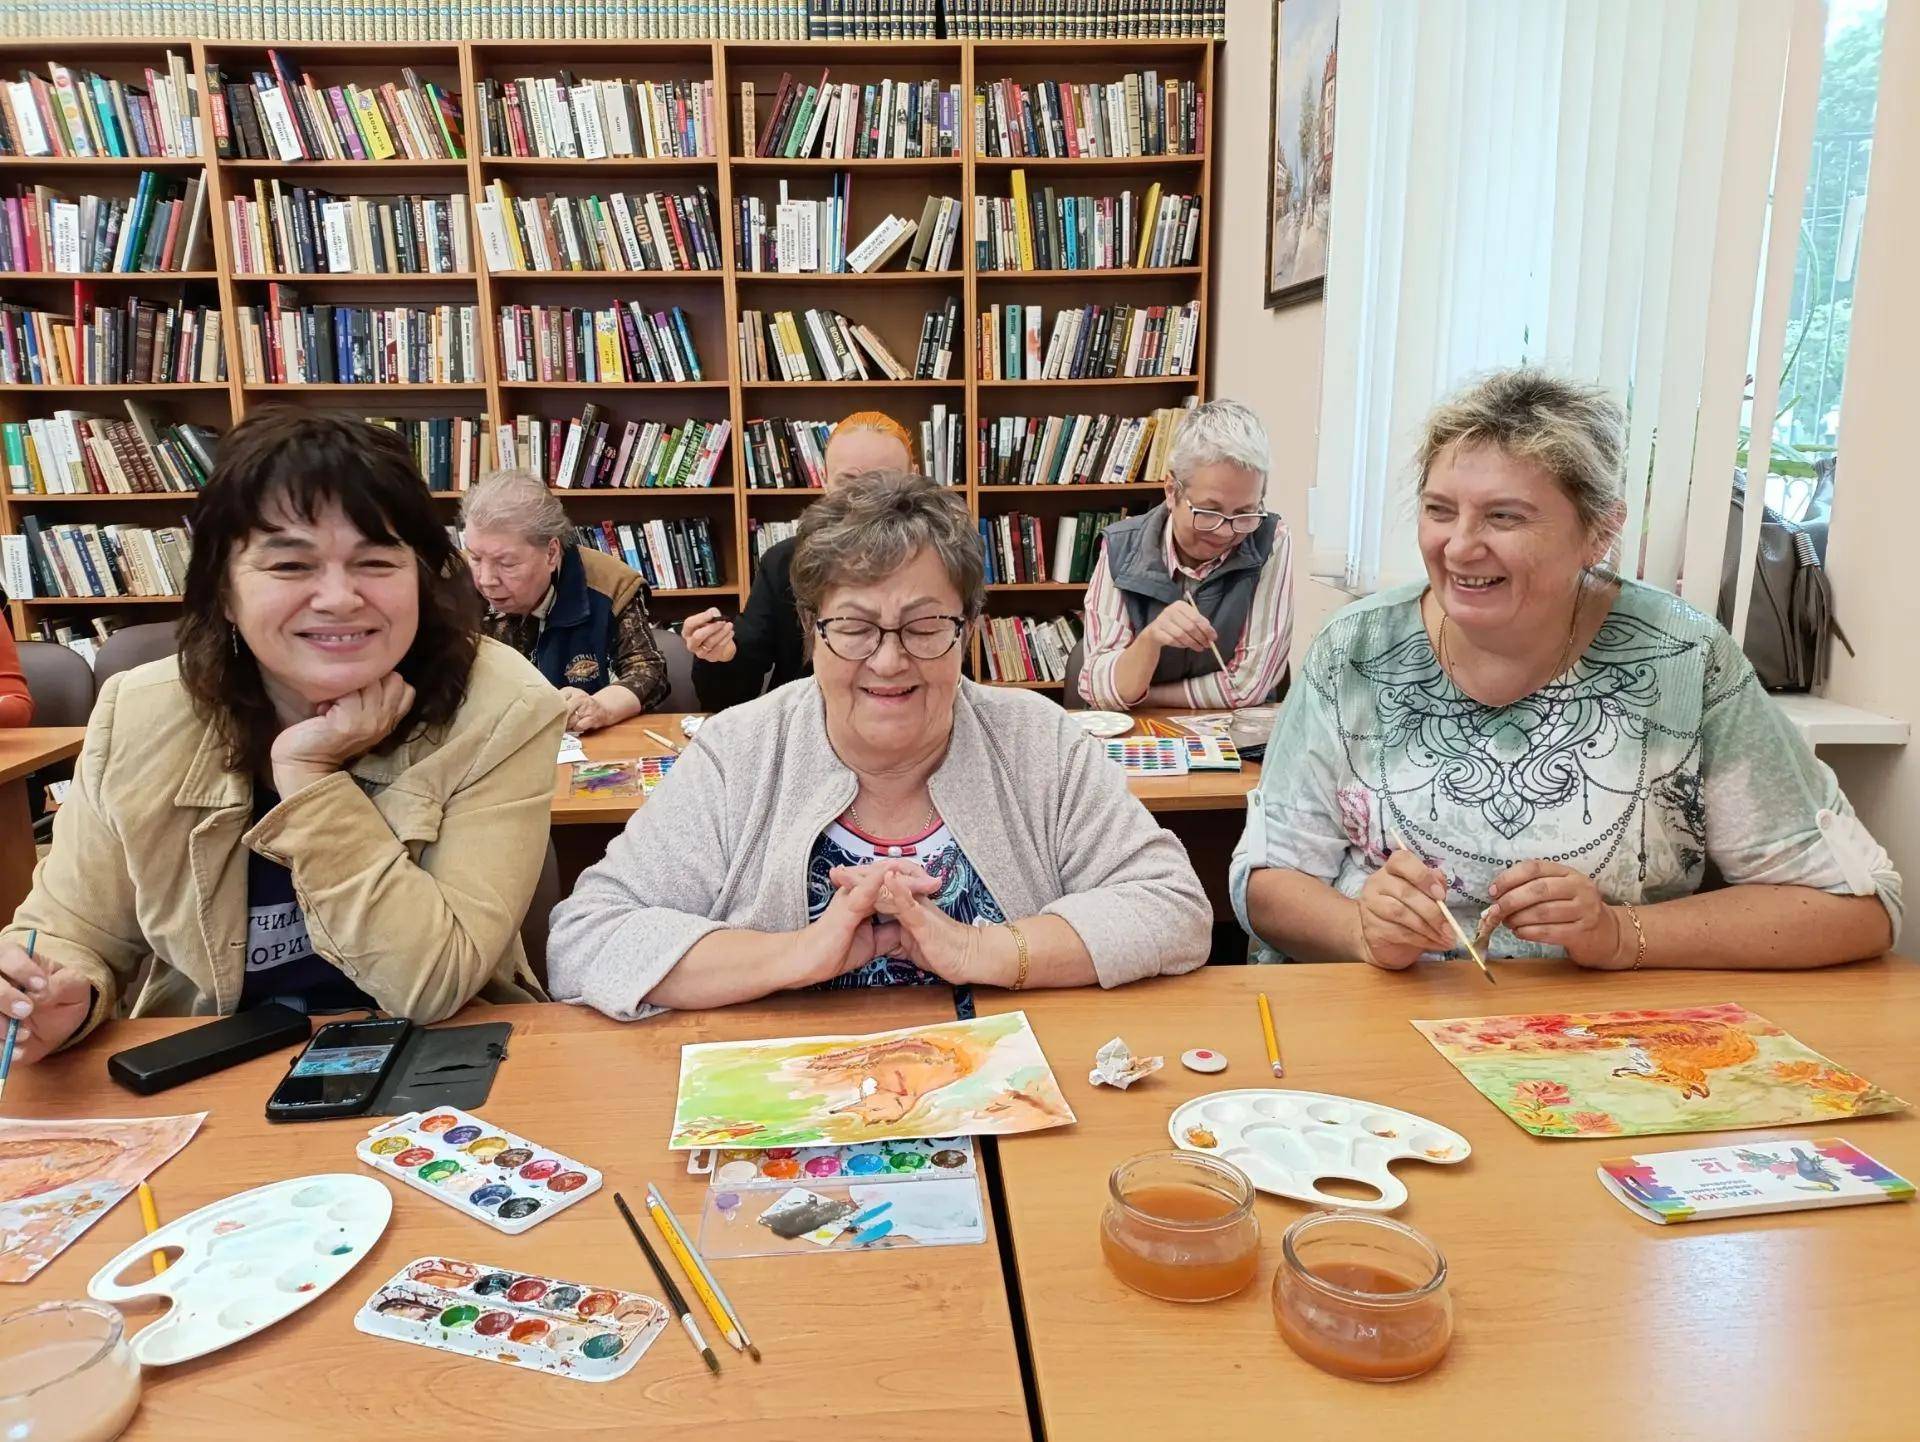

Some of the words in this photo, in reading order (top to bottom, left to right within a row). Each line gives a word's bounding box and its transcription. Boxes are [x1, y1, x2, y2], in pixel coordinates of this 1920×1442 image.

[367, 111, 379, 136] Театр
[634, 214, 652, 245] ЦОЙ
[829, 326, 846, 356] Быков
[249, 906, 304, 931] ЧИЛ
[248, 935, 312, 964] ОРИ
[1698, 1162, 1732, 1174] 12
[1692, 1189, 1764, 1201] КРАСКИ
